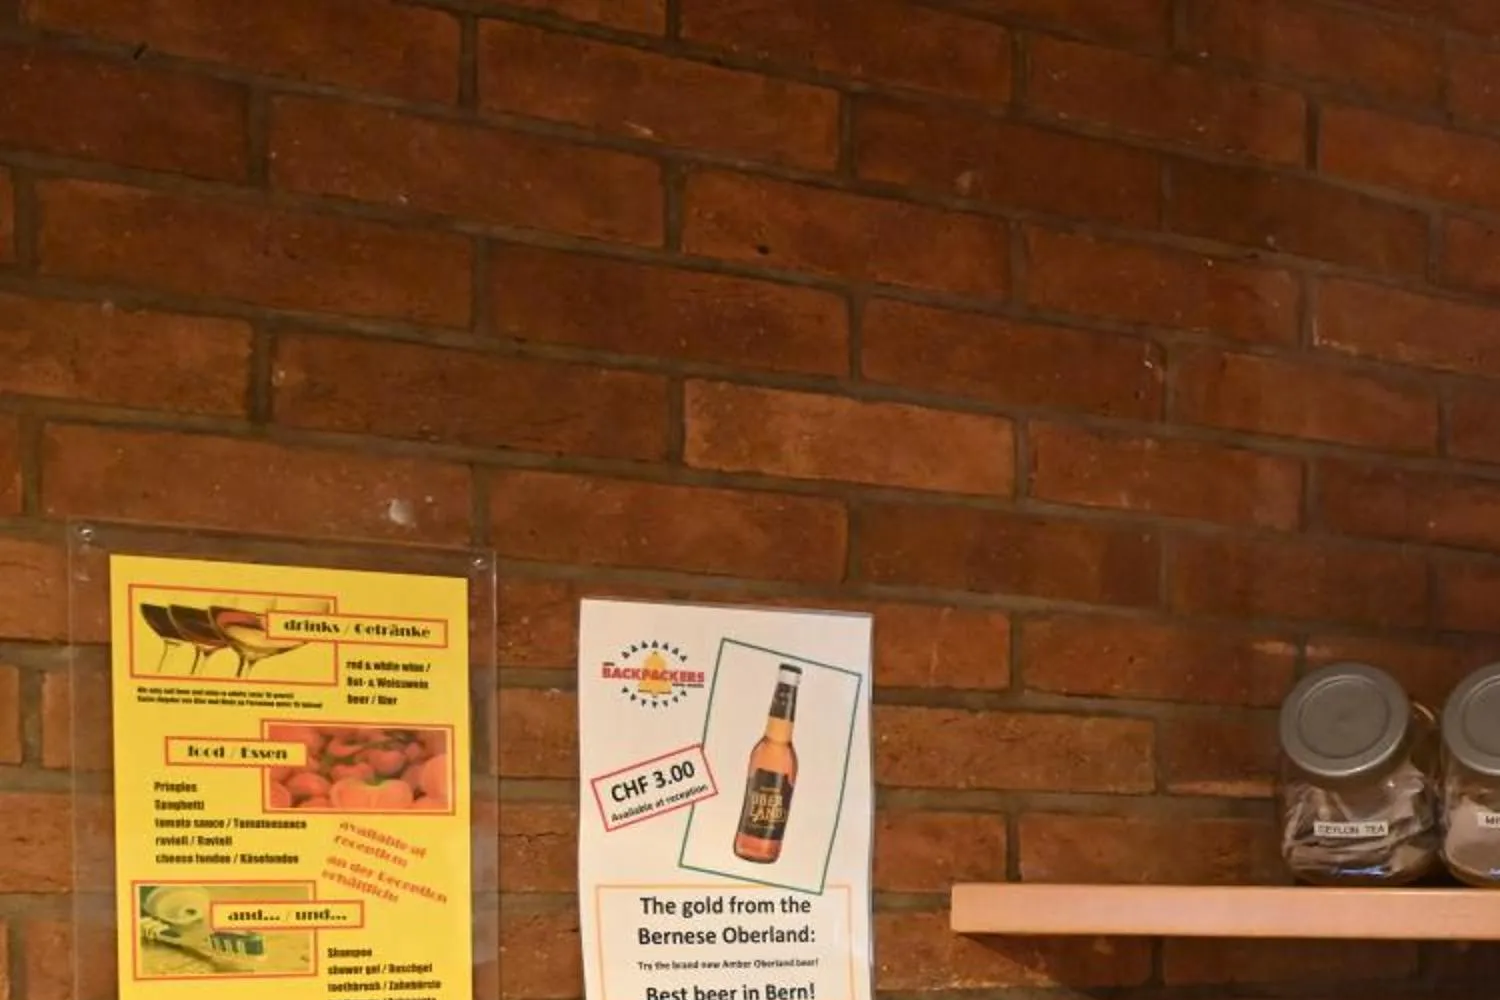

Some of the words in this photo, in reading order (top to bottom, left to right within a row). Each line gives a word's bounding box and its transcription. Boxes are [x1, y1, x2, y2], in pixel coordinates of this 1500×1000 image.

[284, 619, 340, 633] drinks
[602, 667, 704, 682] BACKPACKERS
[188, 745, 224, 758] food
[240, 747, 287, 759] Essen
[154, 782, 197, 793] Pringles
[611, 775, 652, 802] CHF
[652, 761, 695, 789] 3.00
[155, 800, 205, 811] Spaghetti
[611, 804, 653, 822] Available
[655, 799, 664, 808] at
[665, 784, 708, 804] reception
[155, 818, 190, 828] tomato
[194, 819, 224, 828] sauce
[1365, 824, 1385, 833] TEA
[198, 836, 232, 846] Ravioli
[640, 897, 676, 915] The
[681, 896, 723, 918] gold
[729, 896, 775, 914] from
[780, 896, 811, 914] the
[638, 927, 717, 945] Bernese
[722, 925, 816, 944] Oberland:
[655, 961, 670, 970] the
[722, 959, 751, 969] Amber
[753, 958, 794, 969] Oberland
[742, 984, 759, 1000] in
[765, 982, 815, 1000] Bern!
